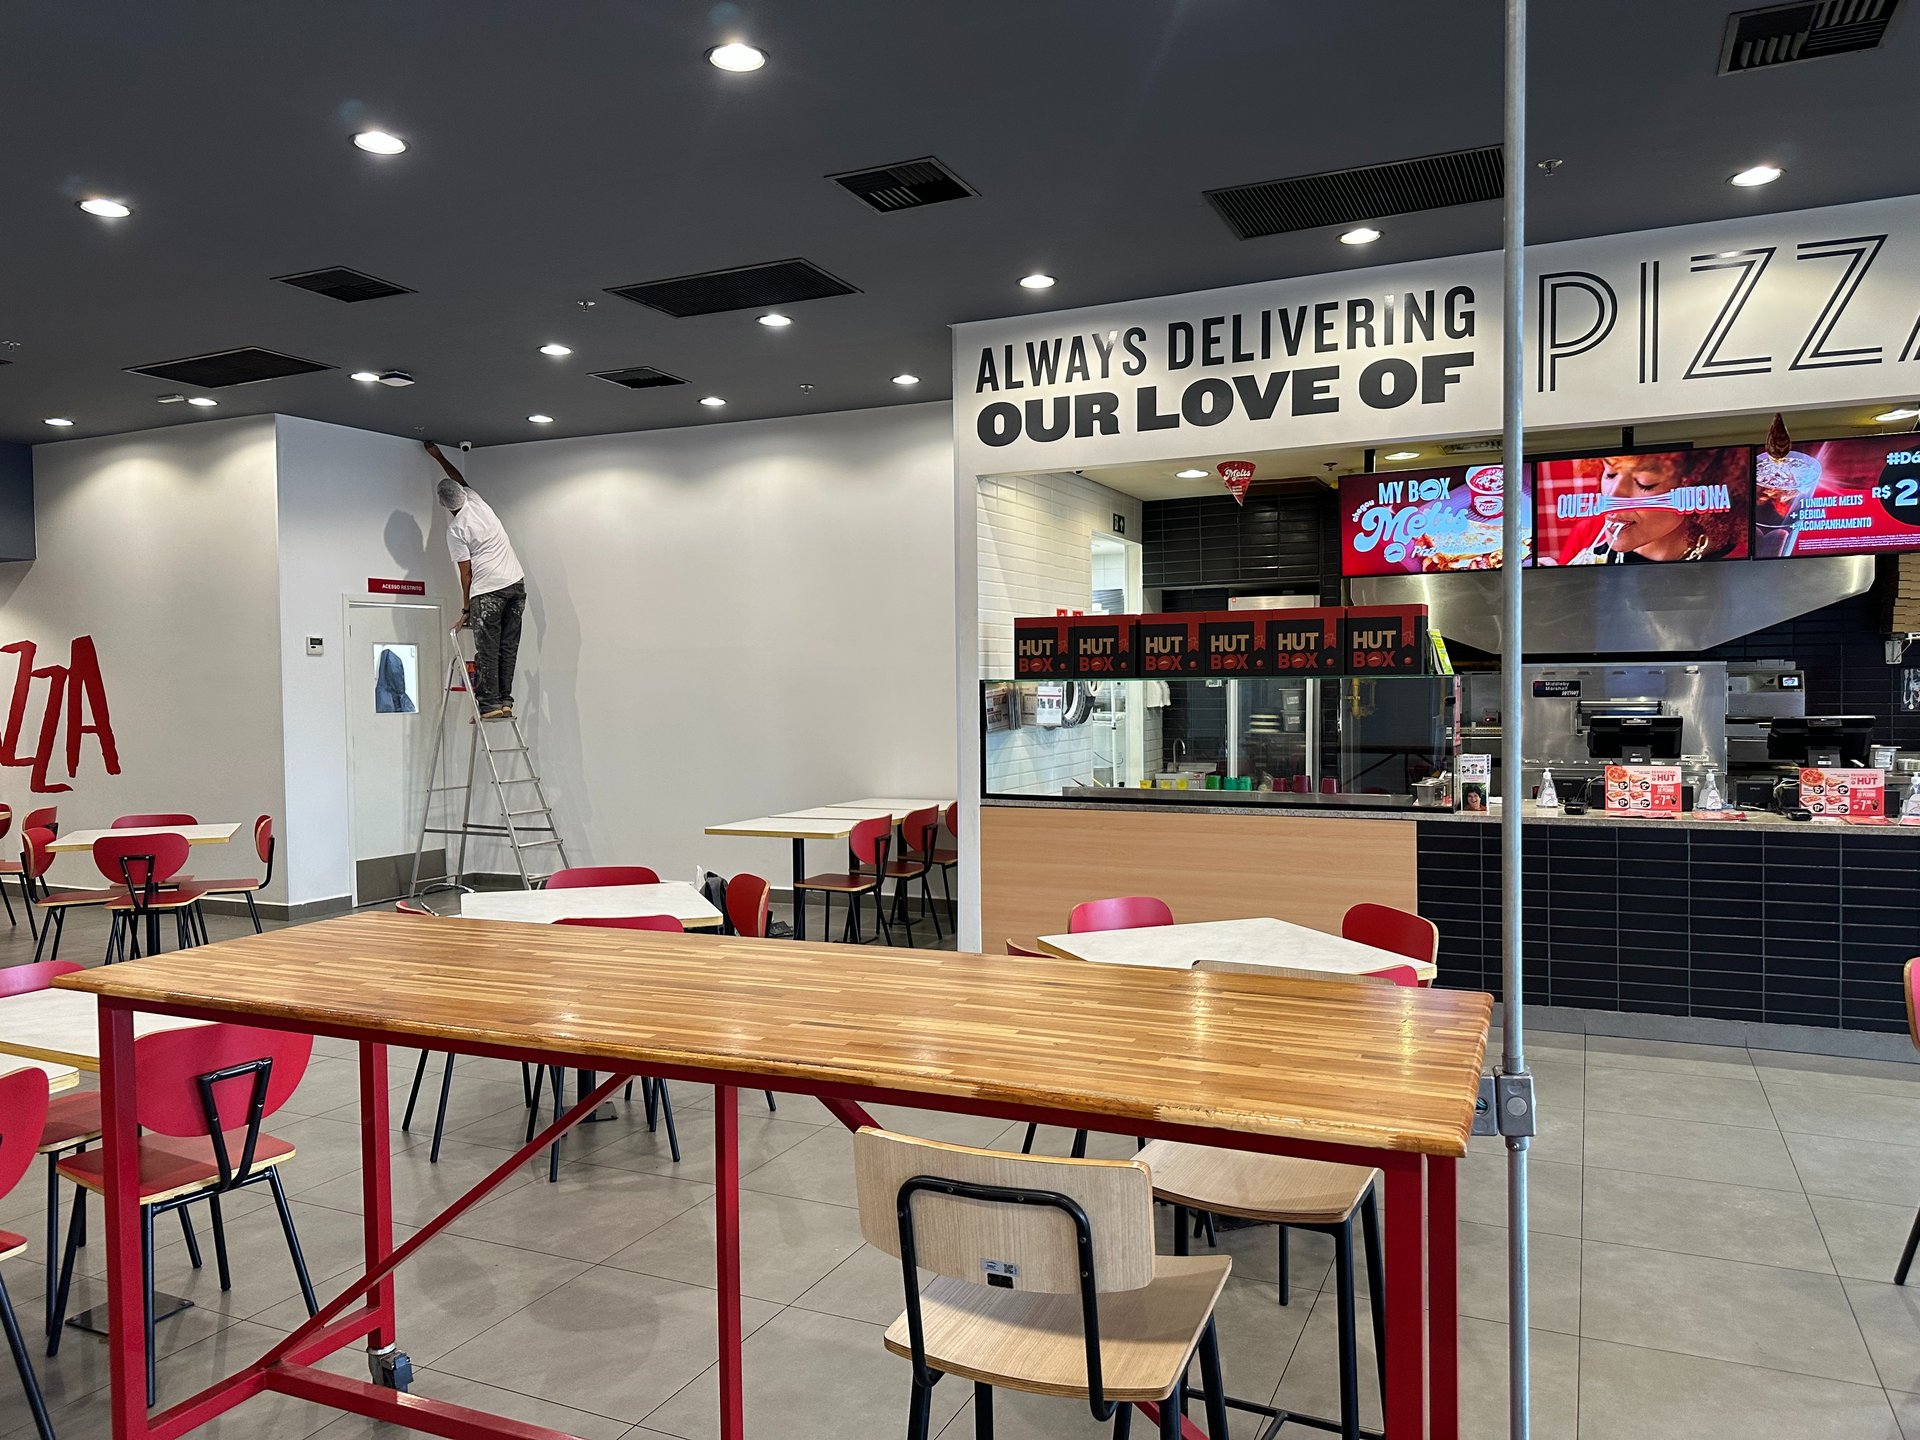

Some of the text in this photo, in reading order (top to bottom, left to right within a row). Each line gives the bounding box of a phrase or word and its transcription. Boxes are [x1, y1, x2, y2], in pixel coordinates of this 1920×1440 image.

[976, 286, 1475, 393] ALWAYS DELIVERING
[976, 352, 1475, 446] OUR LOVE OF
[1378, 477, 1450, 505] MY BOX
[1871, 478, 1920, 507] R$ 2
[1799, 494, 1864, 509] 1 UNIDADE MELTS
[1799, 508, 1826, 520] BEBIDA
[1353, 501, 1469, 553] Melts
[1799, 516, 1873, 532] ACOMPANHAMENTO
[1018, 639, 1054, 656] HUT
[1079, 637, 1114, 655] HUT
[1145, 636, 1183, 654] HUT
[1210, 634, 1249, 652] HUT
[1278, 632, 1319, 651] HUT
[1353, 630, 1396, 649] HUT
[1018, 657, 1054, 673] BOX
[1079, 655, 1114, 672] BOX
[1145, 655, 1183, 671] BOX
[1210, 653, 1249, 670] BOX
[1278, 652, 1318, 669] BOX
[1353, 650, 1396, 668] BOX
[0, 634, 121, 793] ZZA
[1657, 773, 1676, 782] HUT
[1857, 777, 1878, 785] HUT
